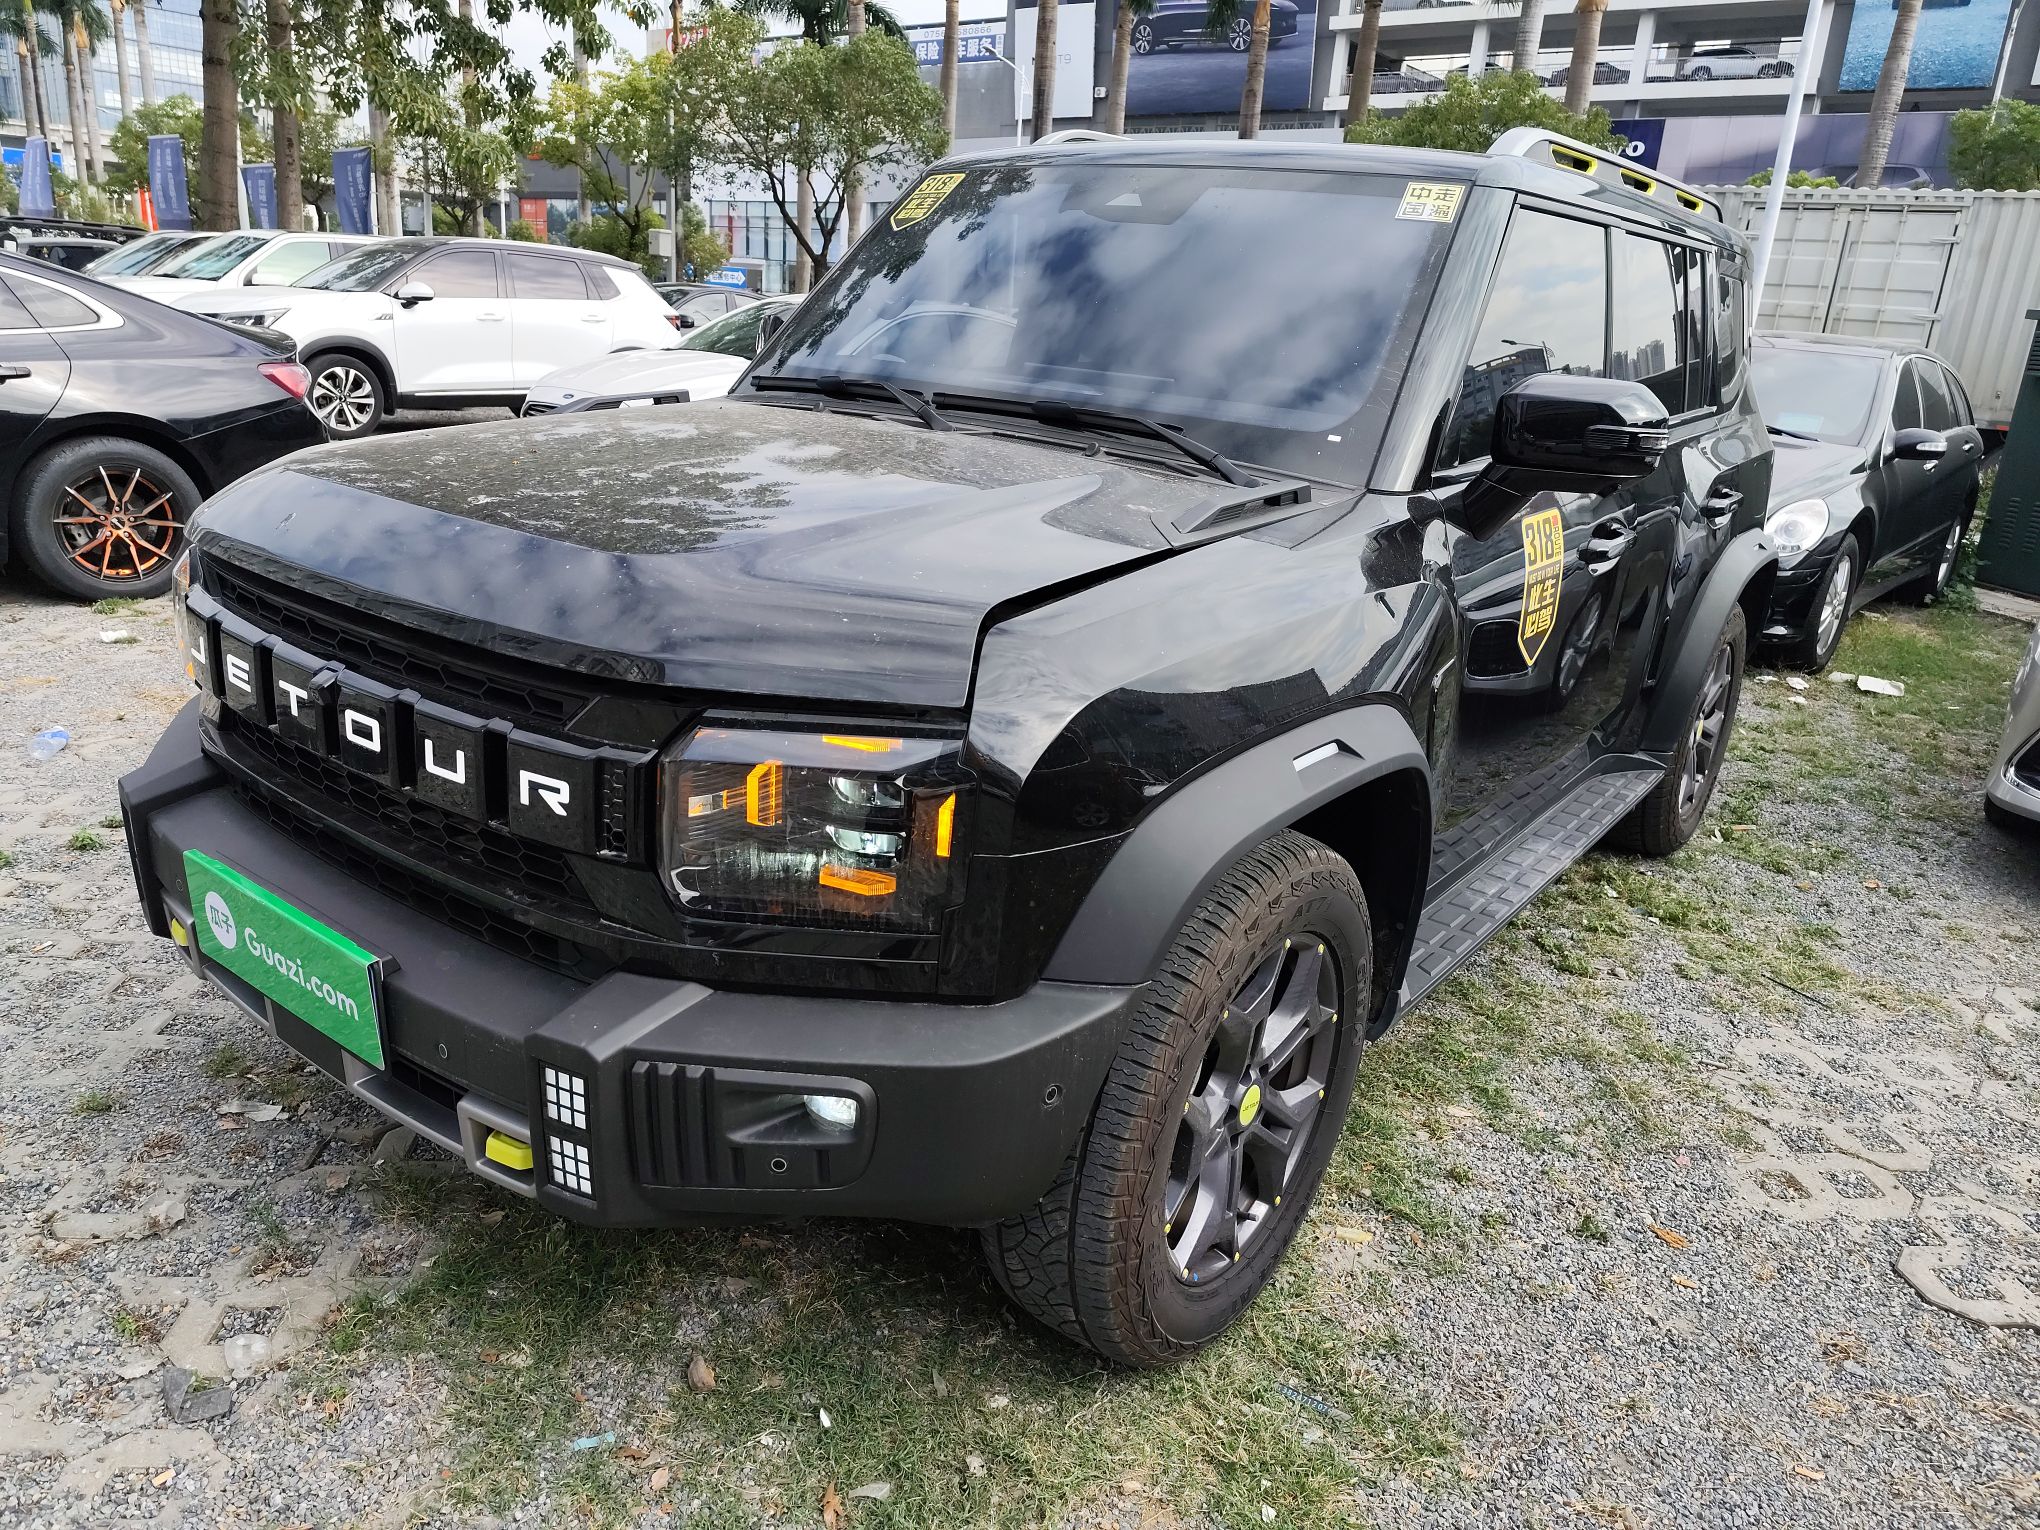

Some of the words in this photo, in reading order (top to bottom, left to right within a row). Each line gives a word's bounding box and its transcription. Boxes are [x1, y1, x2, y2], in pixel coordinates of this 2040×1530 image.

[918, 176, 955, 192] 318
[1525, 516, 1555, 566] 318
[1552, 526, 1562, 559] ROUTE
[1528, 579, 1557, 613] 此生
[190, 635, 570, 817] JETOUR
[209, 904, 233, 936] 瓜子
[244, 927, 359, 1022] Guazi.com
